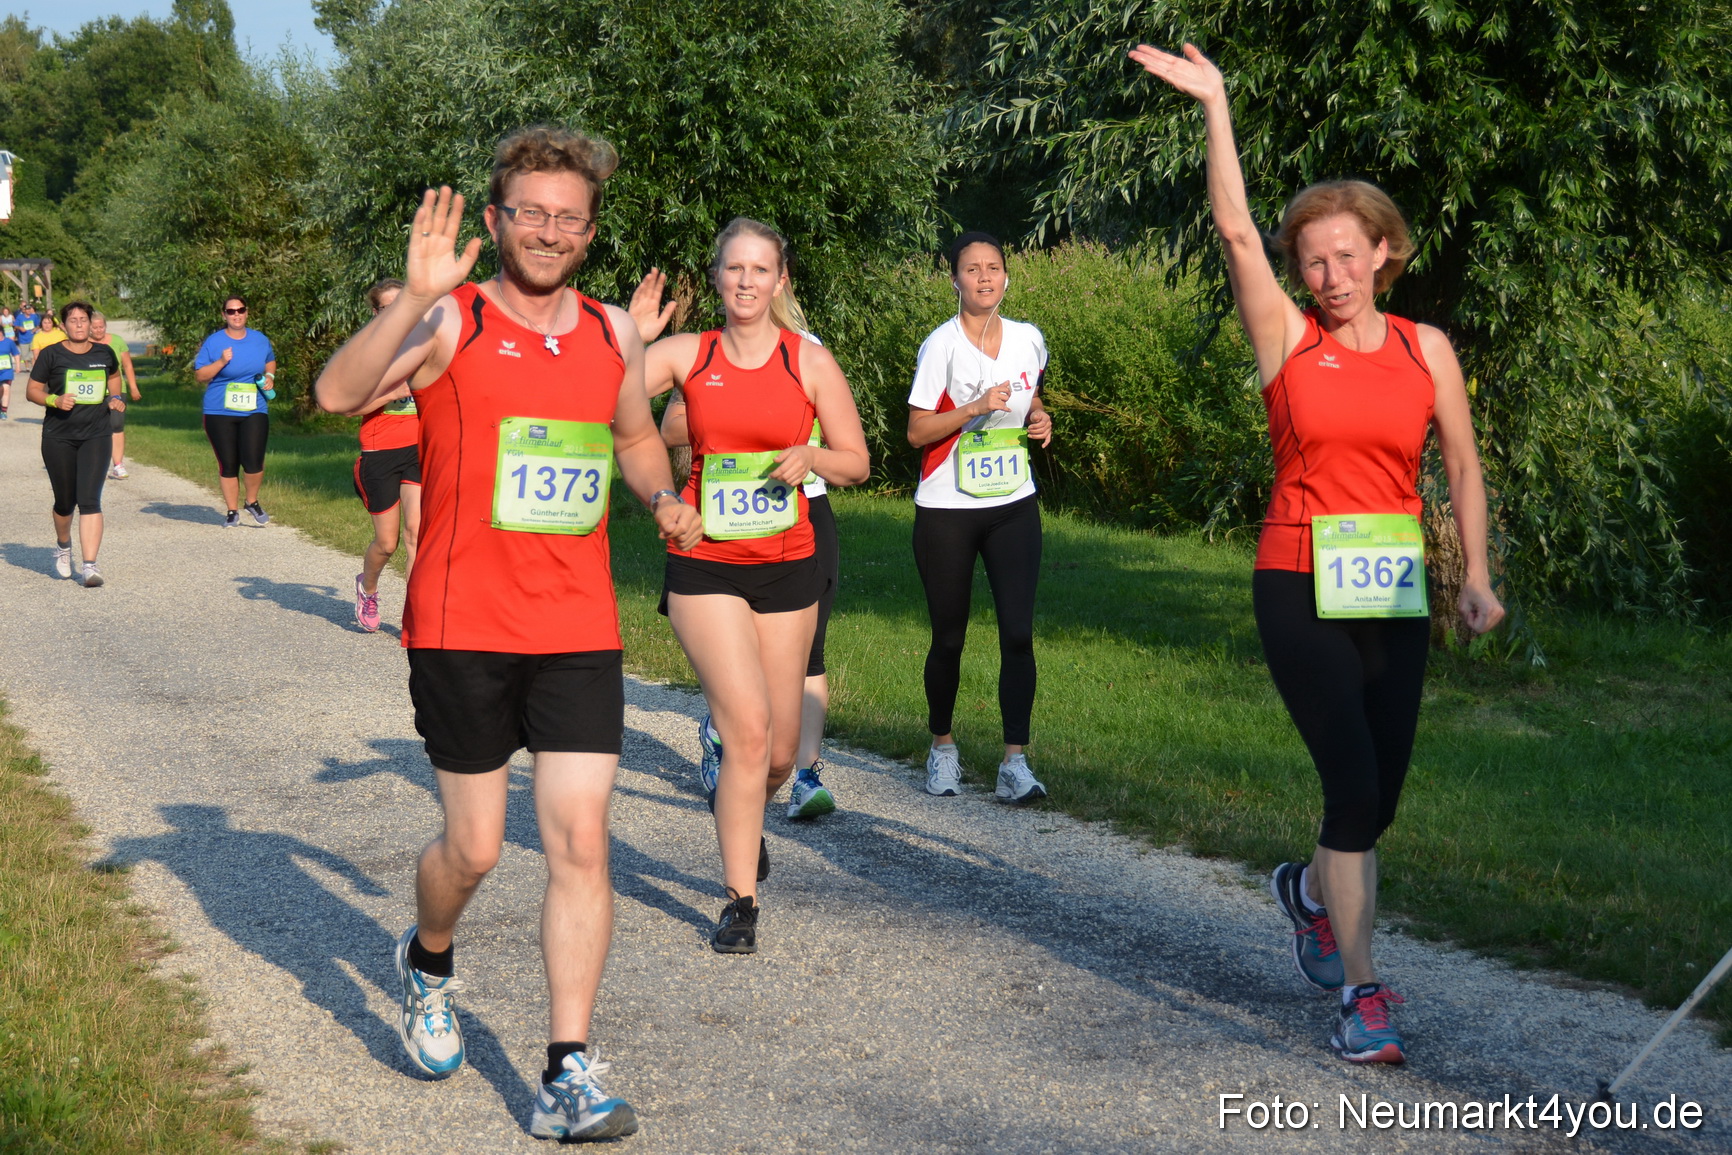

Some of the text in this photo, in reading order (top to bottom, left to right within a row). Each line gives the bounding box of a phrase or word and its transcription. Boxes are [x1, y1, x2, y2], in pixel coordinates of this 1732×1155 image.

[78, 384, 94, 395] 98
[231, 394, 251, 404] 811
[519, 436, 563, 448] firmenlauf
[966, 454, 1018, 479] 1511
[511, 464, 601, 504] 1373
[712, 485, 788, 515] 1363
[530, 508, 579, 518] Günther Frank
[1328, 556, 1414, 589] 1362
